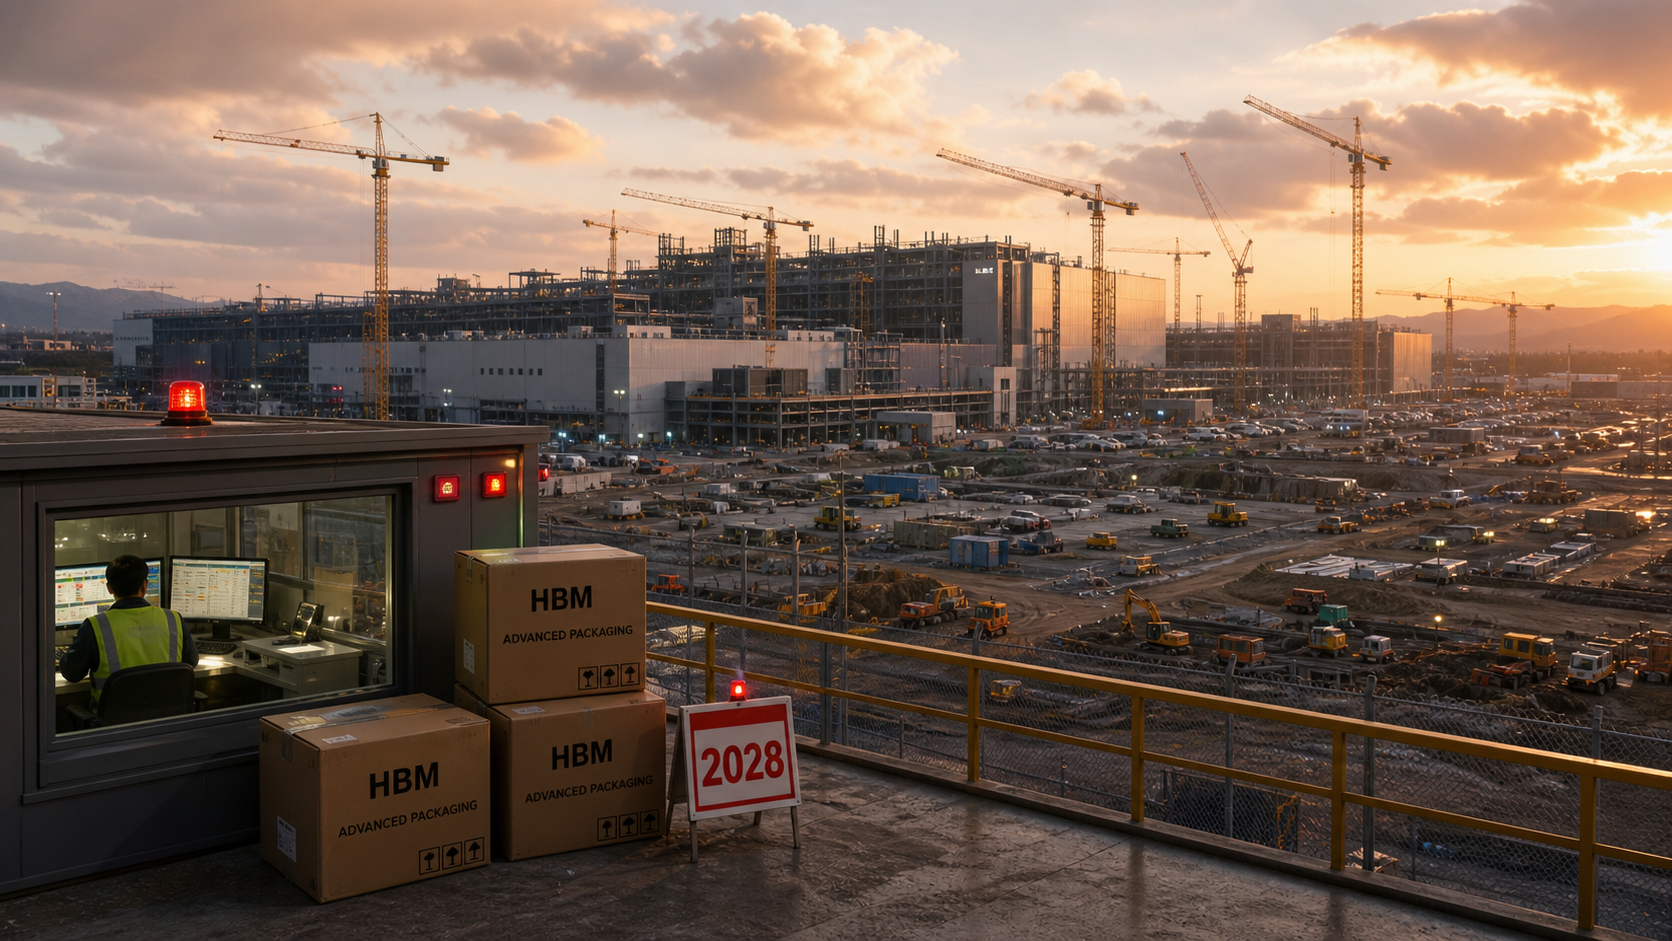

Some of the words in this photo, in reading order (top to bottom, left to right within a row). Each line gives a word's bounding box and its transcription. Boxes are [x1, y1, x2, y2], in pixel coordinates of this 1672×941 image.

[531, 585, 593, 613] HBM
[502, 630, 567, 645] ADVANCED
[569, 624, 633, 640] PACKAGING
[551, 738, 613, 771] HBM
[701, 740, 785, 787] 2028
[369, 761, 439, 800] HBM
[525, 785, 588, 804] ADVANCED
[590, 774, 654, 794] PACKAGING
[338, 814, 408, 838] ADVANCED
[410, 799, 478, 824] PACKAGING
